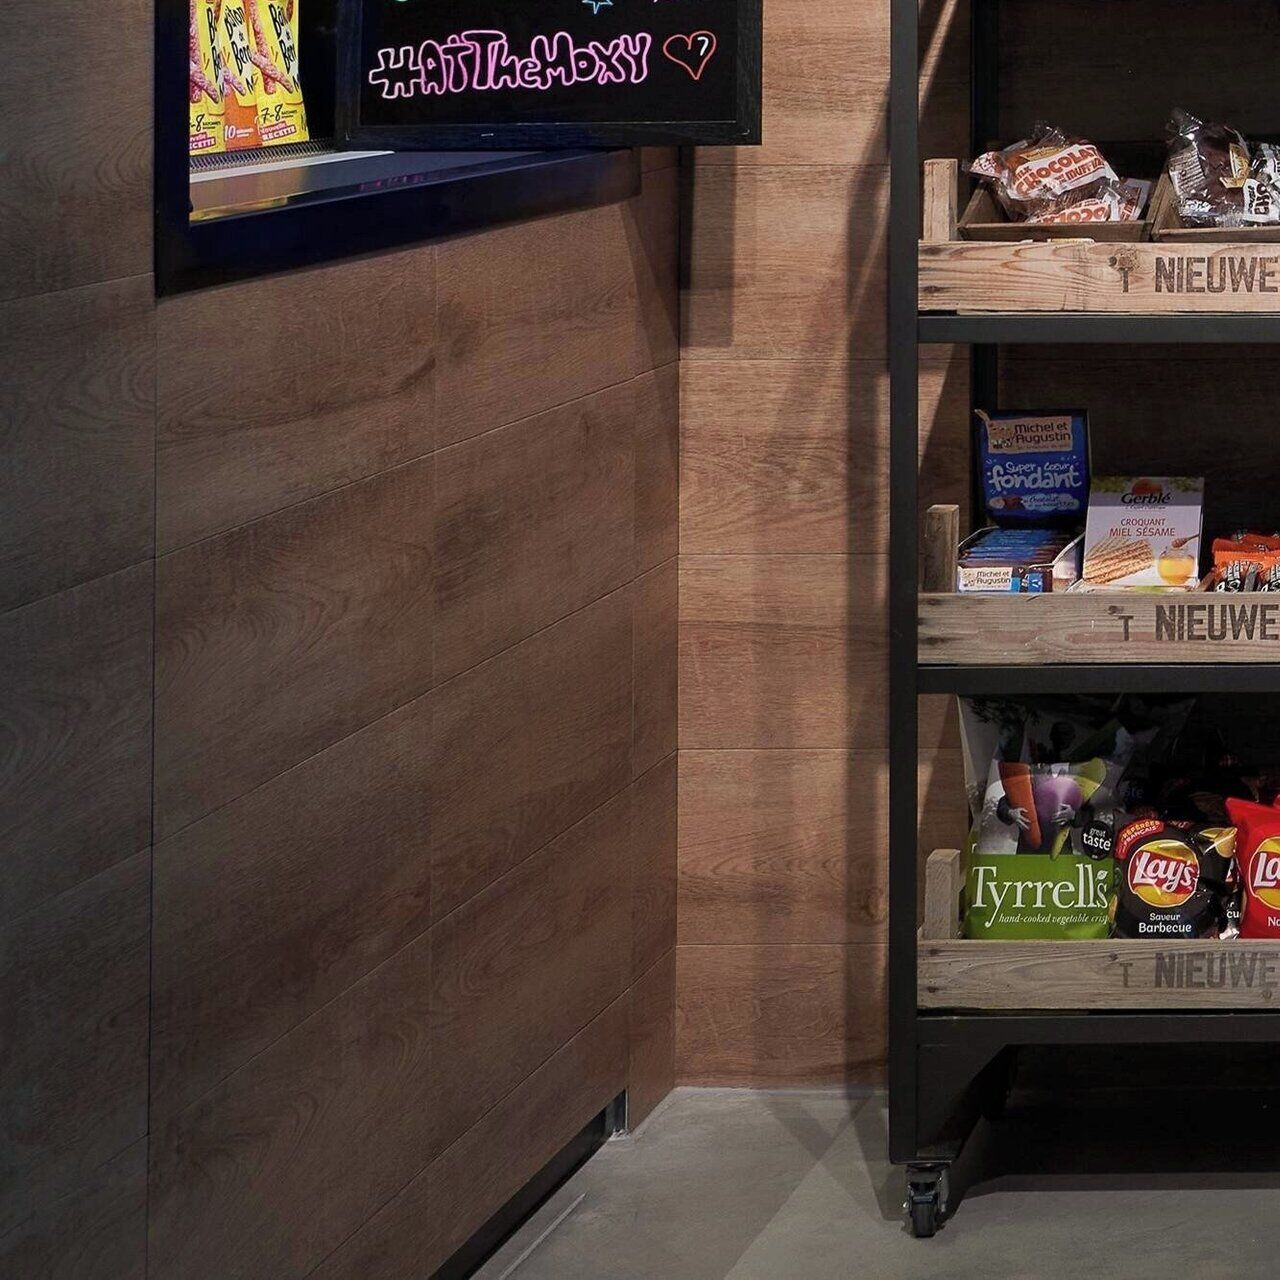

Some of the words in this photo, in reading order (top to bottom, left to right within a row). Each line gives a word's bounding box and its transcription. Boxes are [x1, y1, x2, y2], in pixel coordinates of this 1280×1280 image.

[1155, 257, 1280, 295] NIEUWE
[1014, 421, 1055, 434] Michel
[1056, 421, 1068, 432] et
[1016, 431, 1072, 446] Augustin
[1005, 461, 1035, 474] Super
[988, 464, 1082, 491] fondant
[1121, 492, 1171, 505] Gerblé
[1121, 518, 1166, 528] CROQUANT
[1109, 527, 1132, 537] MIEL
[1136, 525, 1176, 537] SÉSAME
[976, 570, 1001, 579] Michel
[1002, 569, 1010, 578] et
[976, 576, 1011, 586] Augustin
[1155, 603, 1280, 642] NIEUWE
[1090, 826, 1106, 838] great
[1083, 834, 1112, 851] taste
[1132, 851, 1199, 893] Lay's
[999, 912, 1051, 924] hand-cooked
[1051, 914, 1088, 926] vegetable
[1150, 912, 1181, 921] Saveur
[1138, 922, 1193, 934] Barbecue
[1155, 952, 1279, 989] NIEUWE
